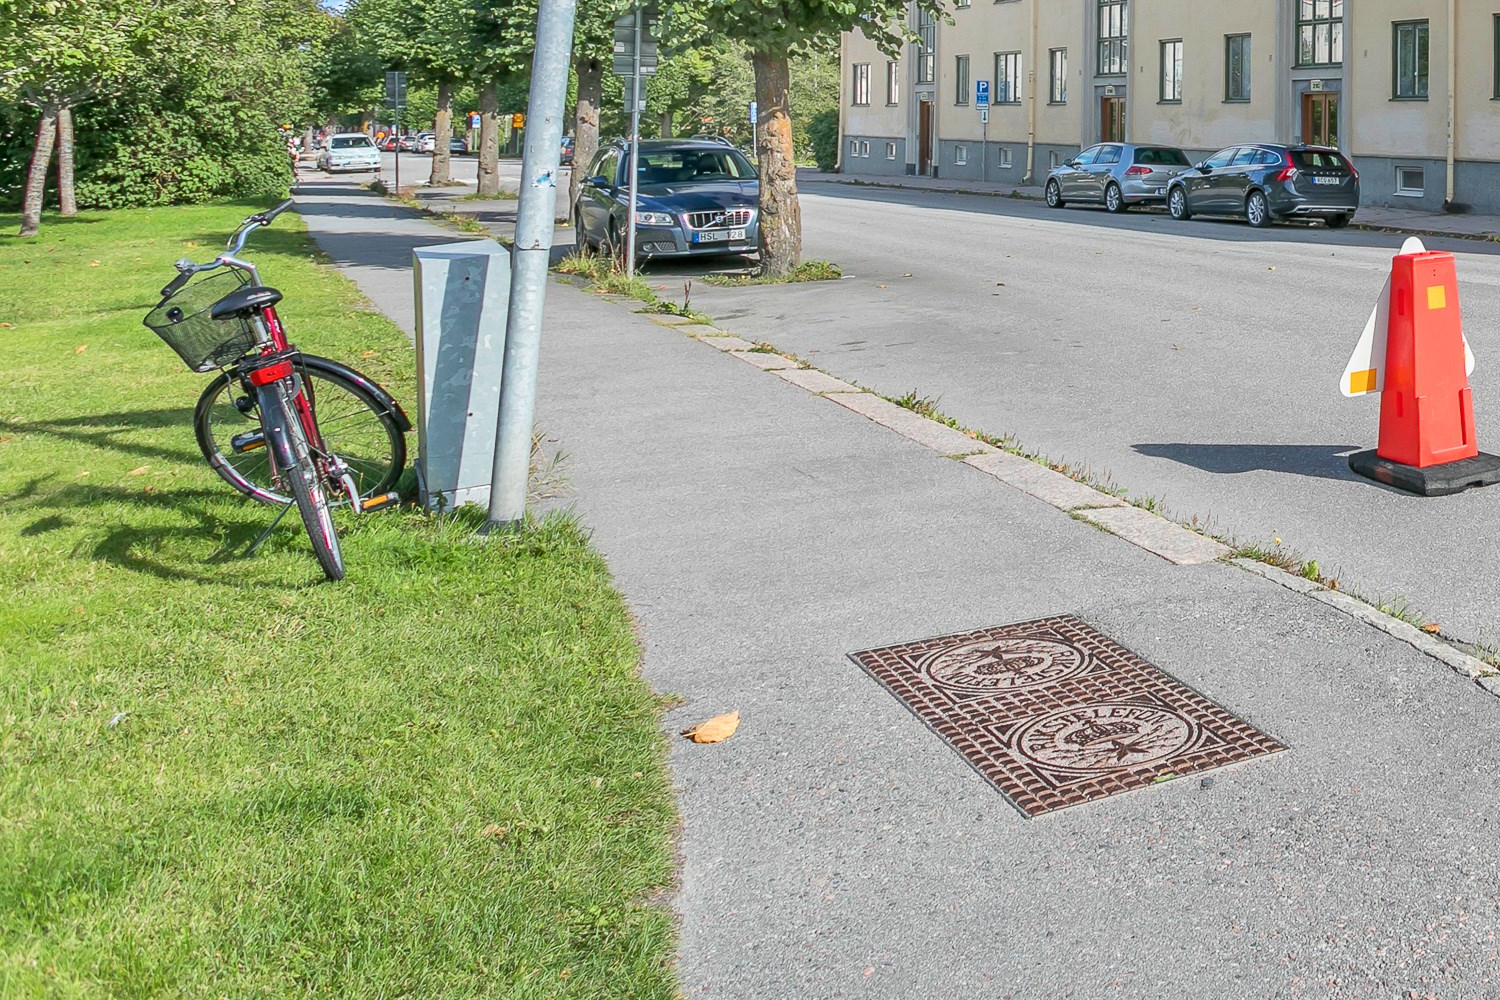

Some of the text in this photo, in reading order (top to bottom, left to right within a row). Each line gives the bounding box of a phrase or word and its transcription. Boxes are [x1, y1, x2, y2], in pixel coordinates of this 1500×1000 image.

[979, 81, 988, 92] P
[700, 231, 744, 241] HSL 128
[1027, 706, 1174, 753] RIKSTELEFON
